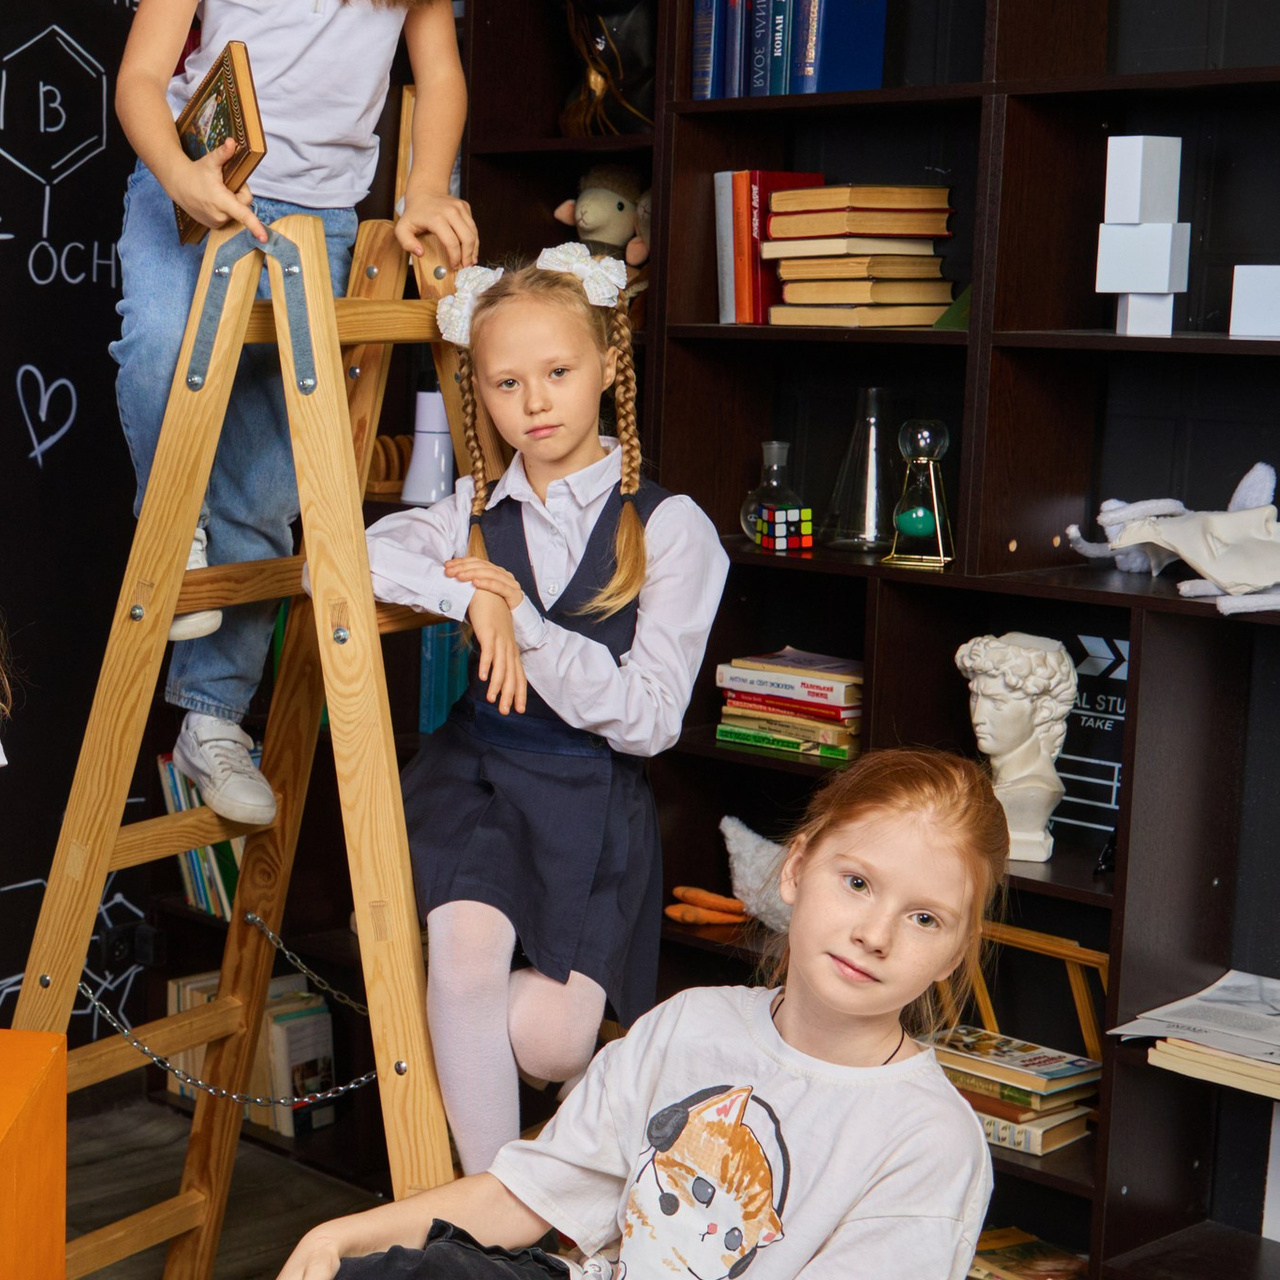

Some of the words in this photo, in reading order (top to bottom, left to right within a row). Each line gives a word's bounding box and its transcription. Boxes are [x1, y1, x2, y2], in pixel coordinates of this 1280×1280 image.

[773, 14, 784, 58] КОНАН
[753, 45, 766, 88] ЗОЛЯ
[39, 81, 67, 133] B
[1081, 715, 1115, 731] TAKE
